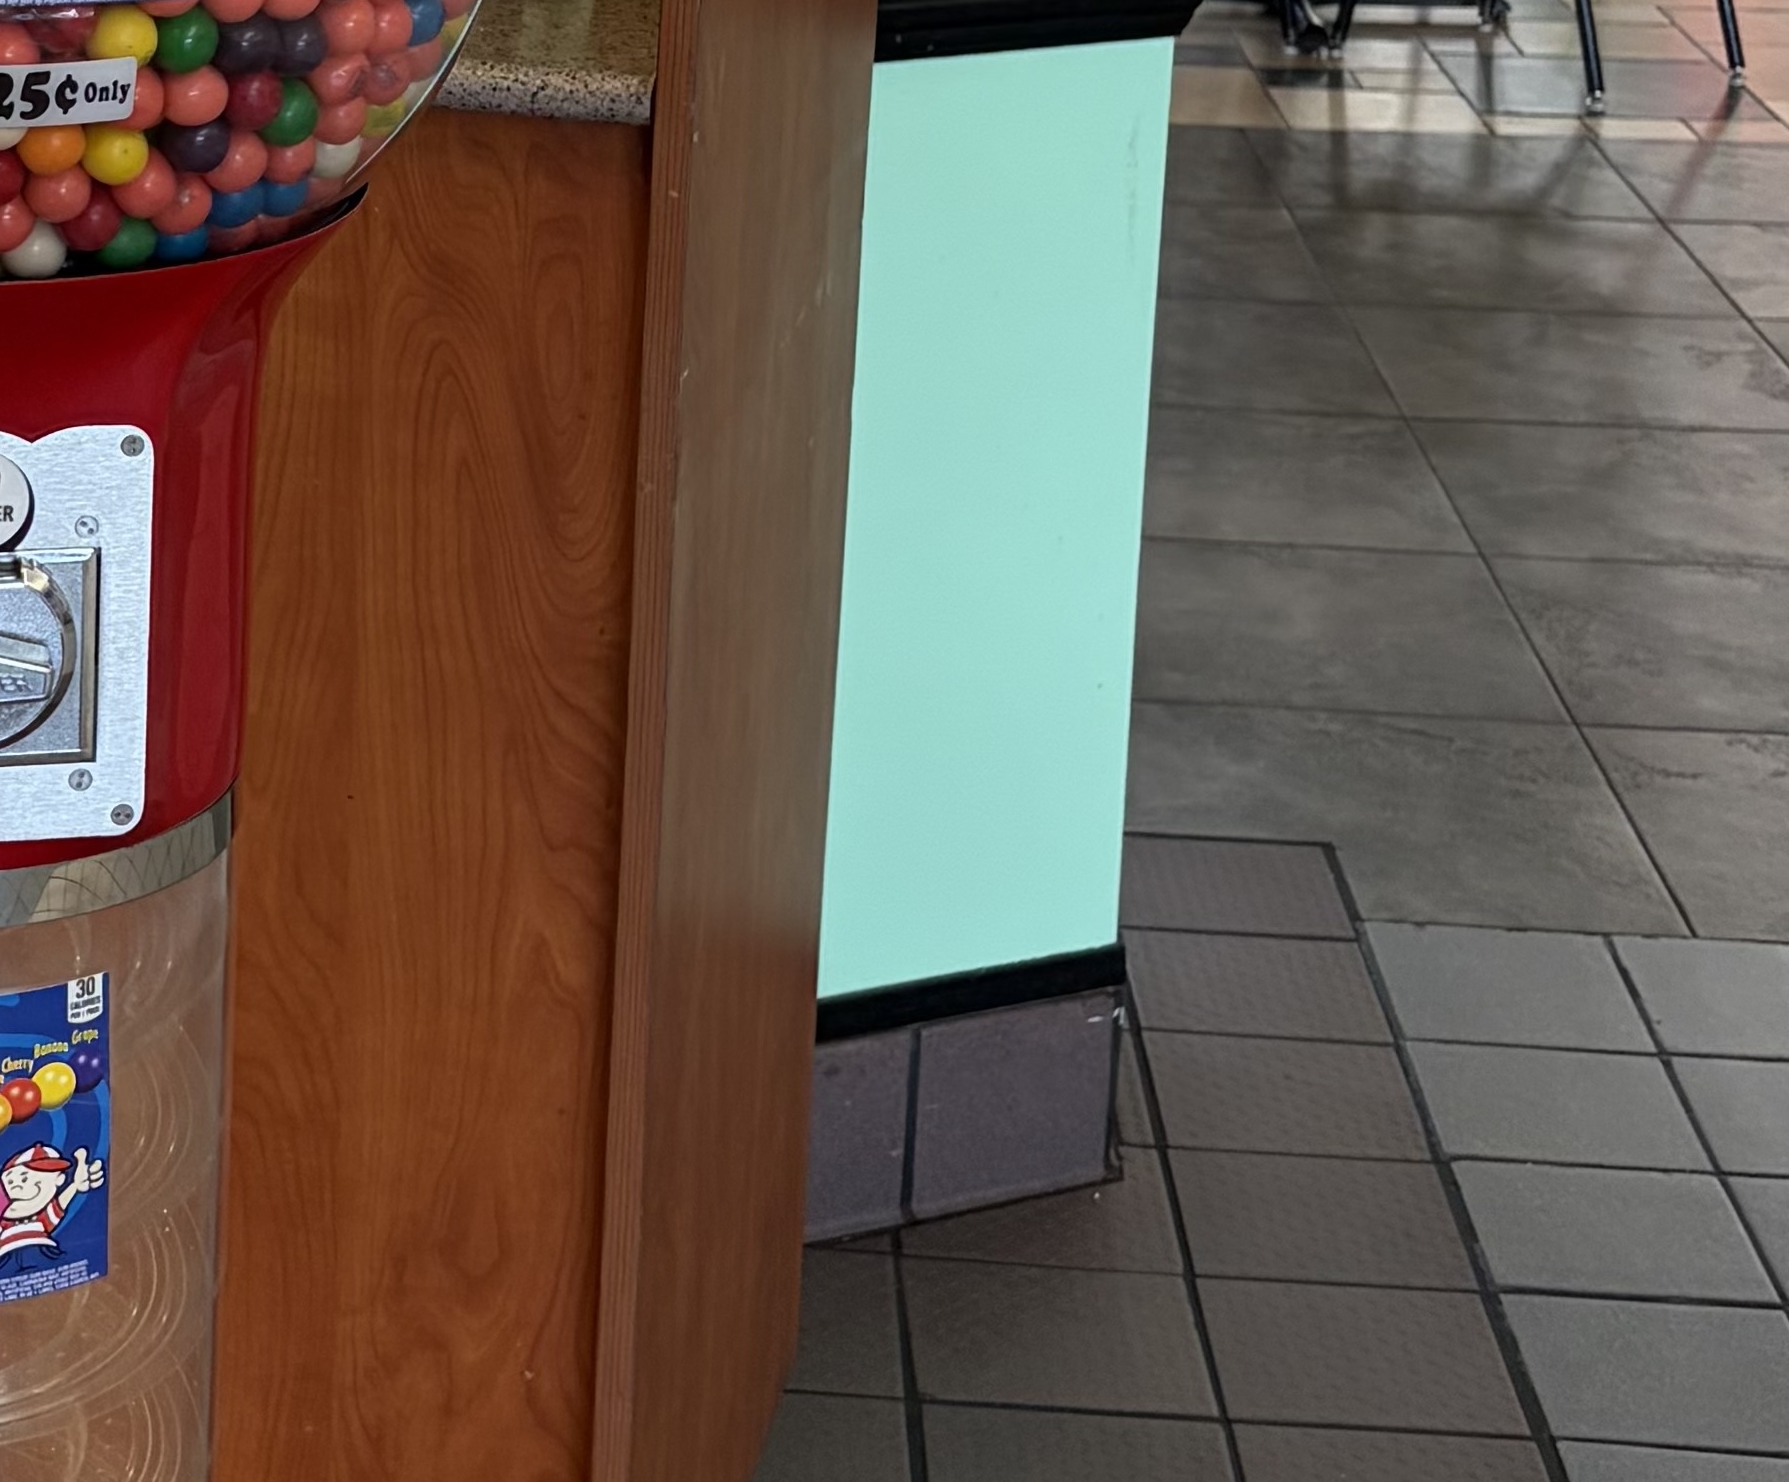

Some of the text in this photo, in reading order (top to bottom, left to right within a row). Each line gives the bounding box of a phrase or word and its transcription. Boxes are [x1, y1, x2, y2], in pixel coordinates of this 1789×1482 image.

[84, 79, 132, 105] Only
[75, 976, 96, 999] 30
[71, 1029, 99, 1045] Grape
[1, 1056, 34, 1074] Cherry
